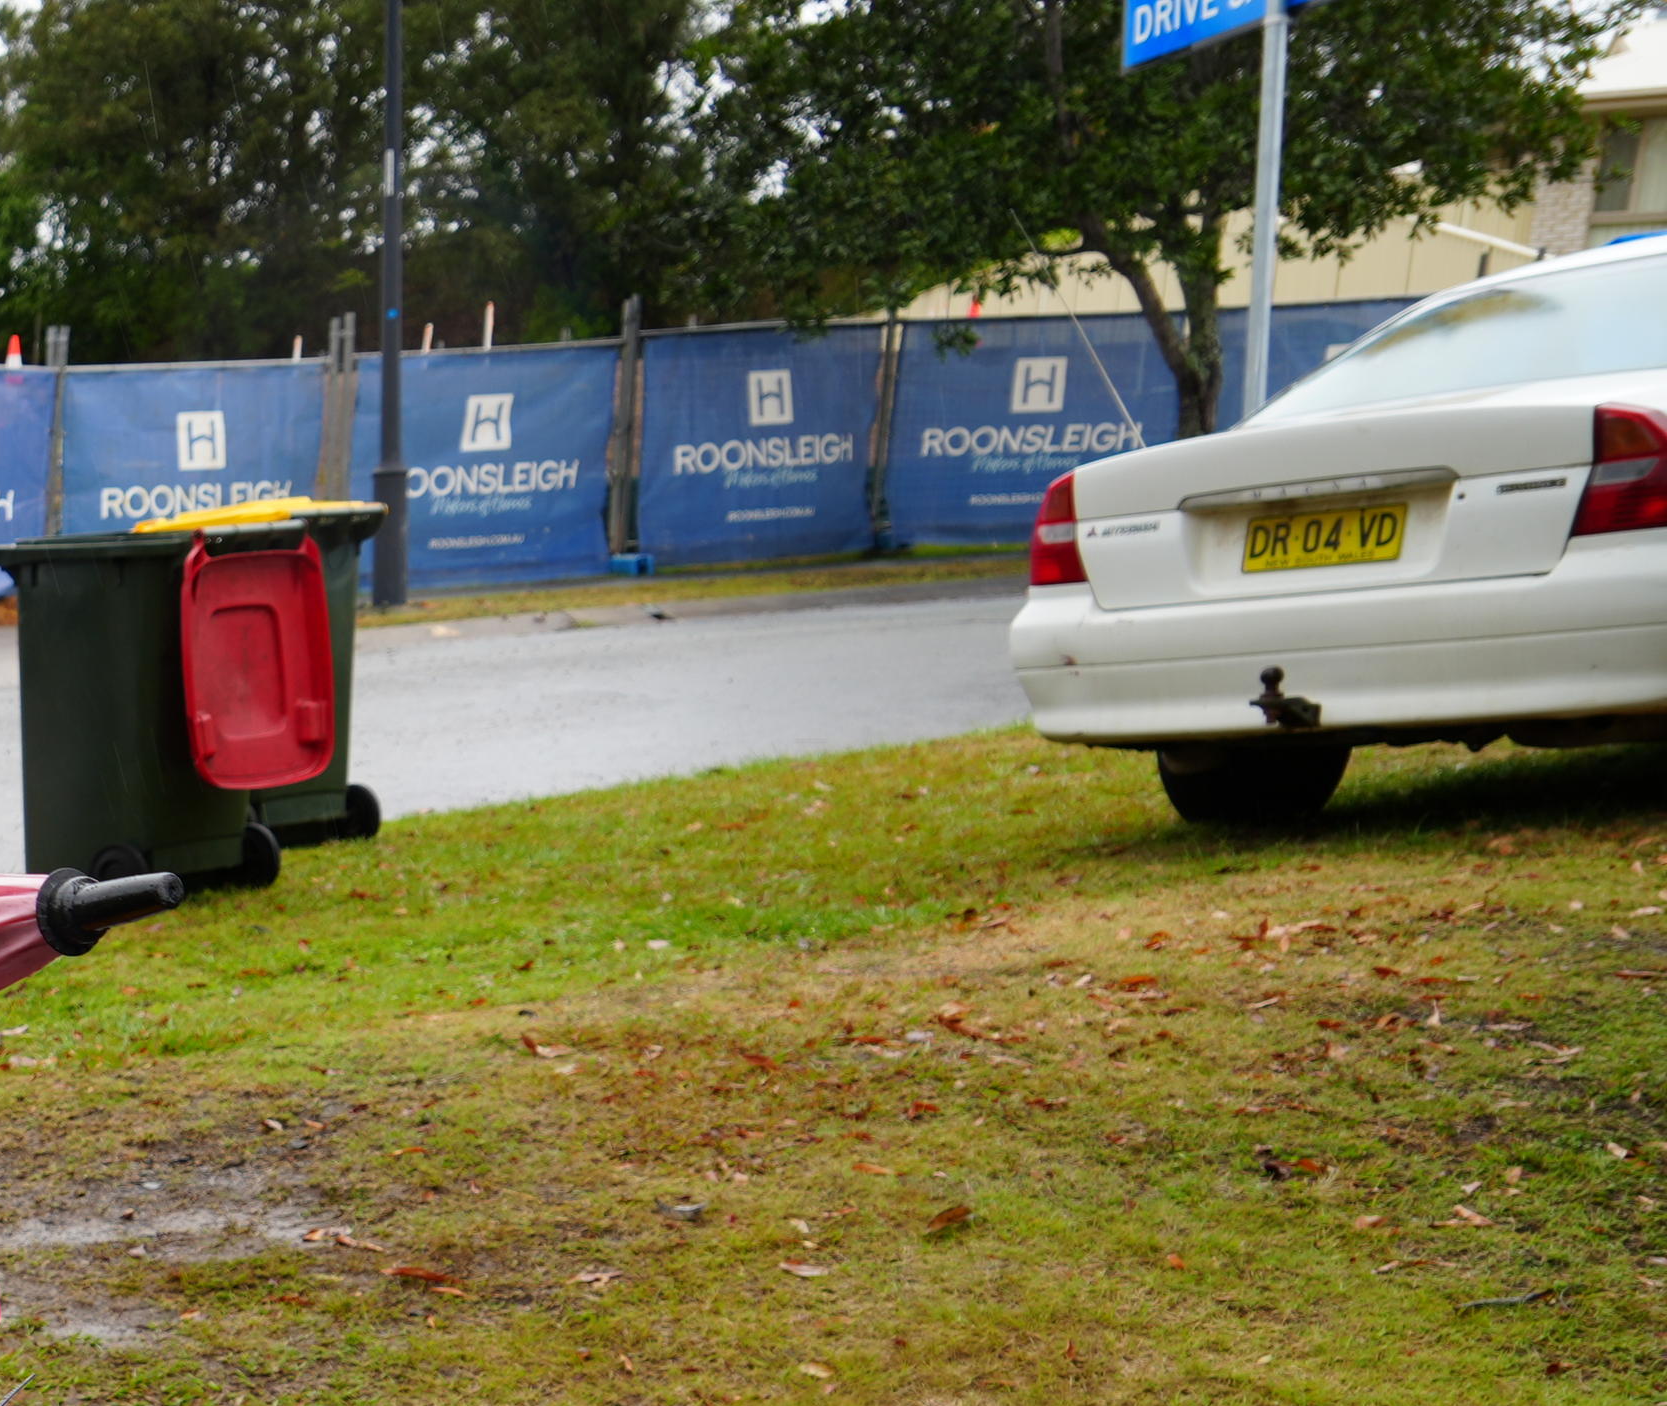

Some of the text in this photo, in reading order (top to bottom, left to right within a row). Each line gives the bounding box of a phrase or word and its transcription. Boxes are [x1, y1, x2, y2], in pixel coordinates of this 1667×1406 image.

[673, 432, 854, 476] ROONSLEIGH
[921, 421, 1144, 458] ROONSLEIGH
[405, 458, 580, 499] OONSLEIGH
